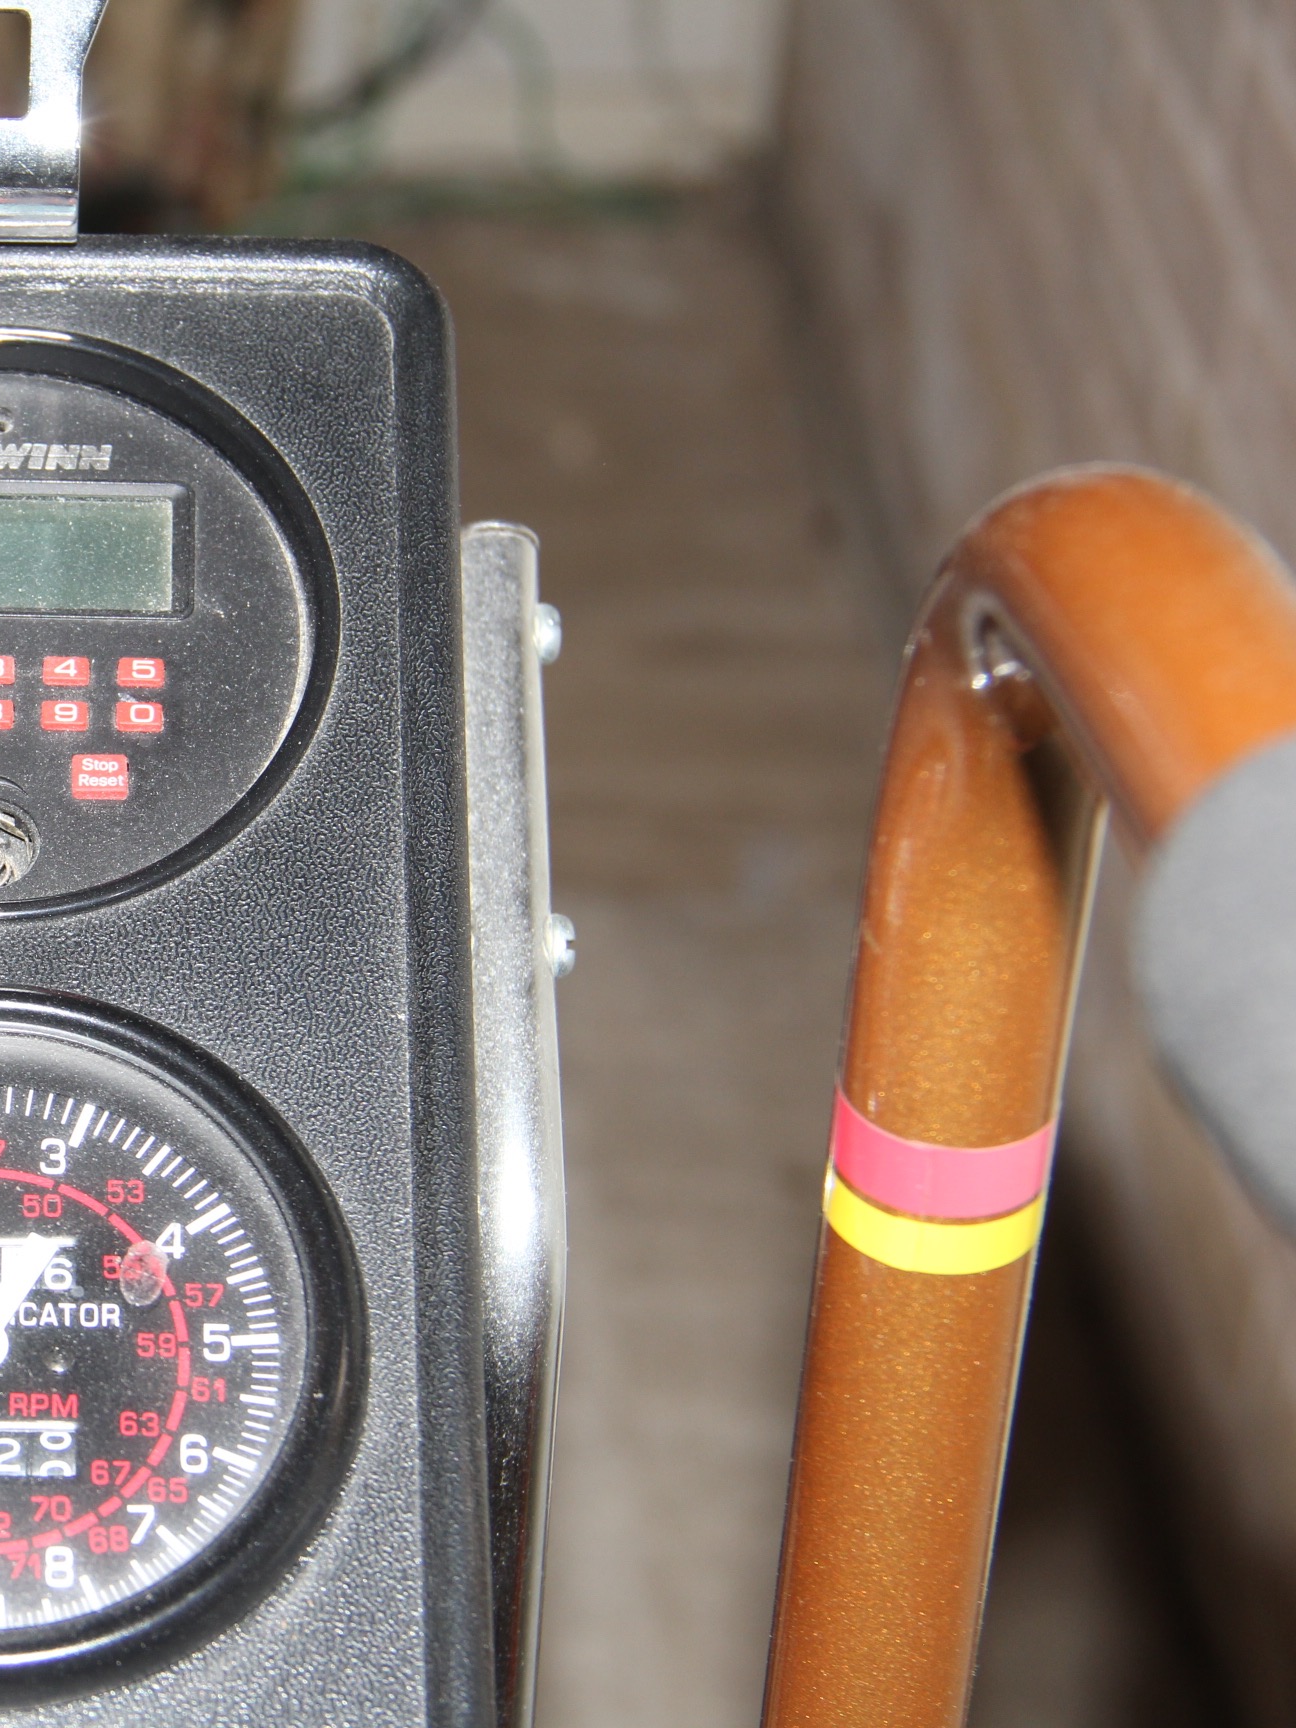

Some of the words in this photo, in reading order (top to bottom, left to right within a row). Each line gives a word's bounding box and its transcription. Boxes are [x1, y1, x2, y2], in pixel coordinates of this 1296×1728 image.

[53, 659, 78, 678] 4
[131, 660, 156, 679] 5
[54, 703, 79, 722] 9
[129, 704, 155, 722] 0
[81, 757, 119, 773] Stop
[78, 773, 125, 787] Reset
[39, 1138, 67, 1175] 3
[106, 1179, 145, 1204] 53
[22, 1193, 63, 1219] 50
[155, 1222, 186, 1260] 4
[184, 1282, 225, 1308] 57
[136, 1332, 176, 1358] 59
[202, 1322, 231, 1362] 5
[190, 1376, 227, 1403] 61
[8, 1392, 80, 1419] RPM
[119, 1410, 160, 1437] 63
[179, 1433, 209, 1474] 6
[90, 1459, 131, 1487] 67
[146, 1476, 189, 1503] 65
[30, 1495, 73, 1523] 70
[126, 1503, 156, 1545] 7
[88, 1525, 129, 1554] 68
[7, 1552, 42, 1580] 71
[44, 1545, 75, 1589] 8
